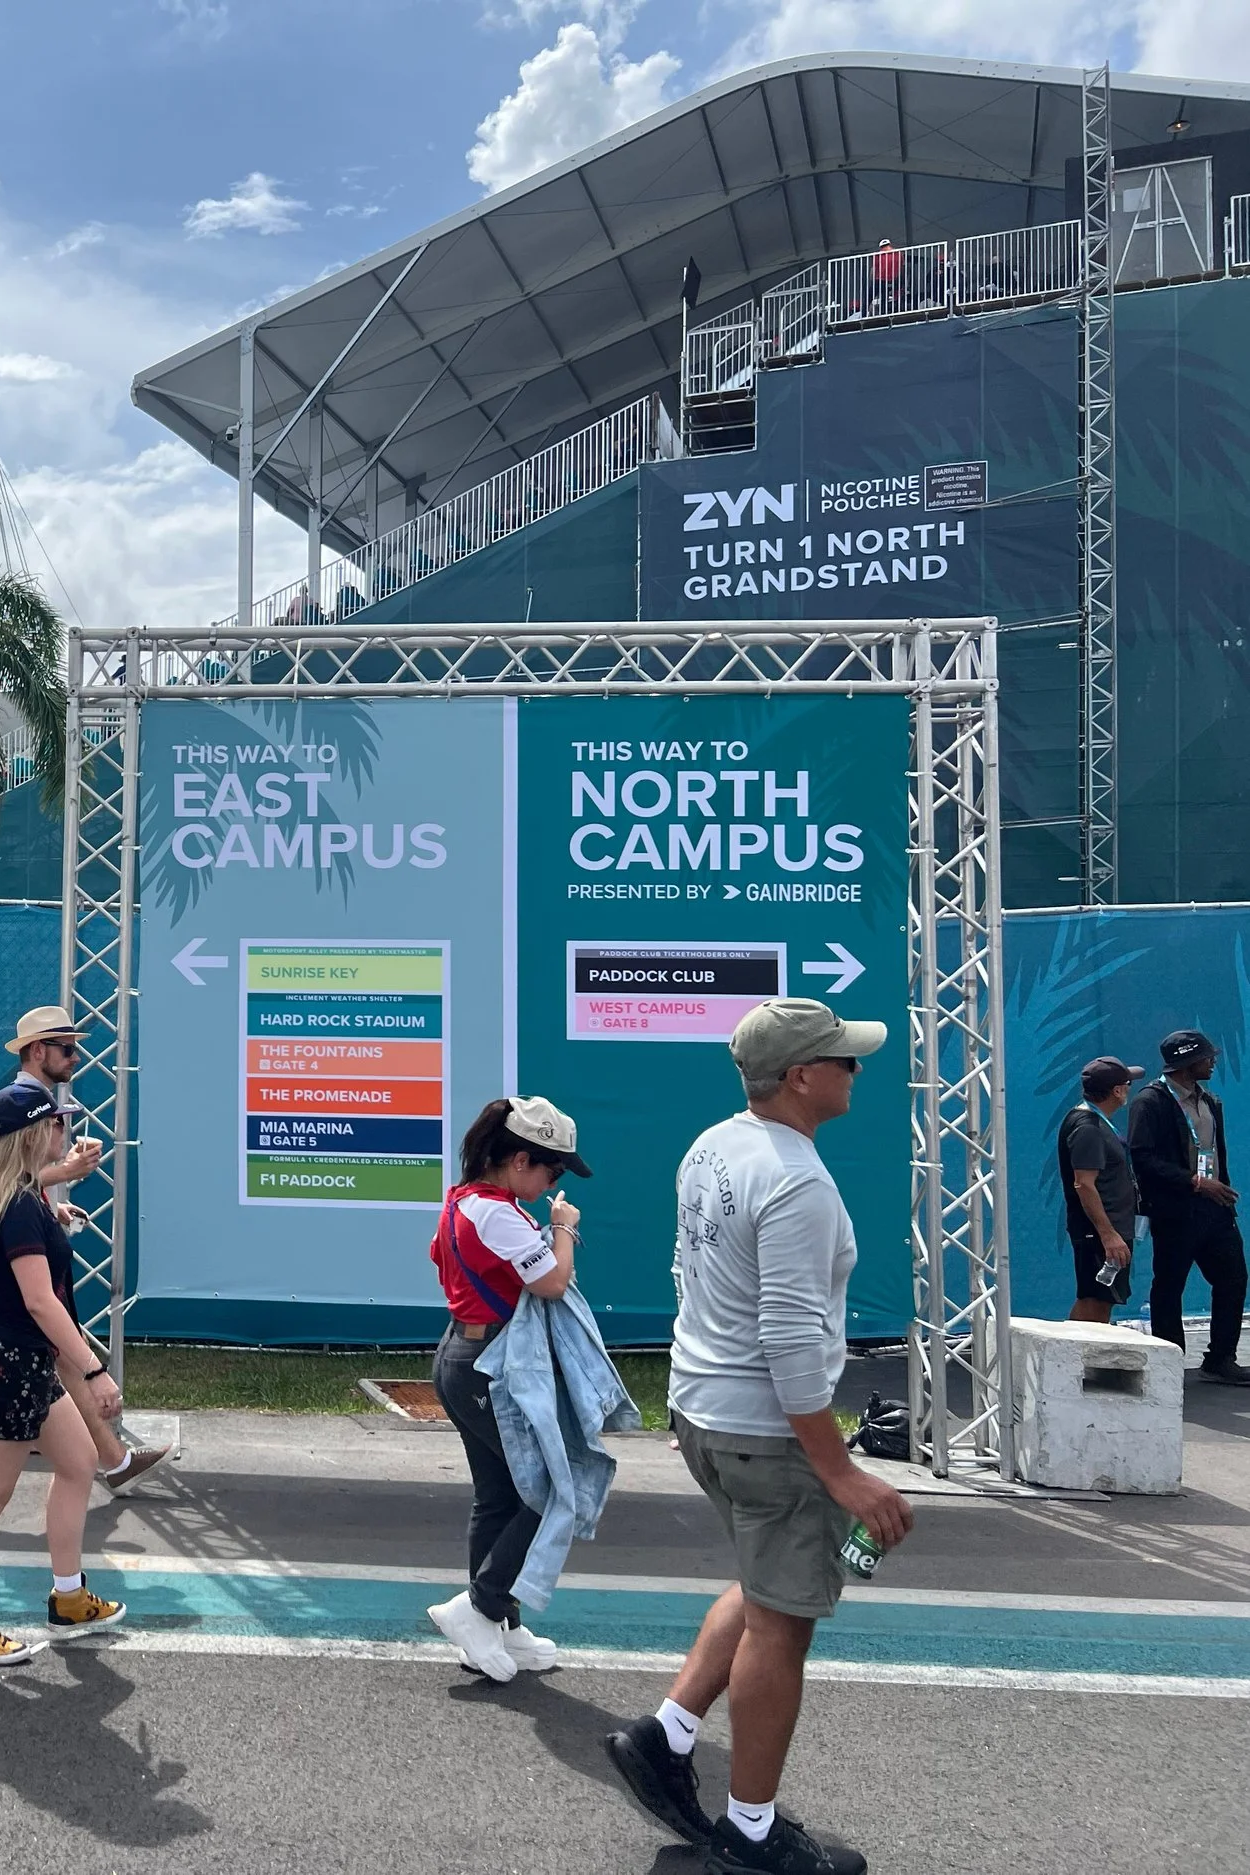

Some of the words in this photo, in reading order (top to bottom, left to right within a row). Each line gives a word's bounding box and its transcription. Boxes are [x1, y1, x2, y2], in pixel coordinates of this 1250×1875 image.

[821, 474, 920, 497] NICOTINE
[931, 476, 955, 485] product
[683, 484, 795, 532] ZYN
[821, 491, 921, 514] POUCHES
[683, 538, 783, 570] TURN
[798, 535, 812, 559] 1
[828, 521, 965, 558] NORTH
[683, 555, 948, 601] GRANDSTAND
[173, 745, 228, 765] THIS
[236, 745, 294, 765] WAY
[303, 745, 337, 765] TO
[572, 741, 632, 761] THIS
[640, 741, 703, 761] WAY
[711, 741, 749, 761] TO
[174, 772, 331, 818] EAST
[572, 770, 809, 818] NORTH
[171, 823, 448, 870] CAMPUS
[569, 824, 864, 872] CAMPUS
[568, 885, 680, 898] PRESENTED
[687, 885, 711, 899] BY
[747, 884, 861, 902] GAINBRIDGE
[261, 967, 325, 978] SUNRISE
[330, 968, 358, 978] KEY
[590, 970, 668, 982] PADDOCK
[672, 971, 714, 982] CLUB
[590, 1002, 633, 1014] WEST
[638, 1003, 706, 1014] CAMPUS
[261, 1014, 303, 1025] HARD
[308, 1015, 350, 1026] ROCK
[355, 1016, 424, 1027] STADIUM
[603, 1017, 637, 1028] GATE
[641, 1019, 648, 1028] 8
[260, 1045, 289, 1057] THE
[294, 1045, 383, 1058] FOUNTAINS
[273, 1060, 305, 1070] GATE
[310, 1061, 318, 1070] 4
[260, 1088, 290, 1101] THE
[293, 1089, 391, 1103] PROMENADE
[260, 1121, 288, 1133] MIA
[293, 1122, 353, 1135] MARINA
[273, 1136, 305, 1146] GATE
[309, 1137, 317, 1146] 5
[261, 1174, 276, 1185] F1
[279, 1174, 355, 1187] PADDOCK
[714, 1158, 736, 1216] CAICOS
